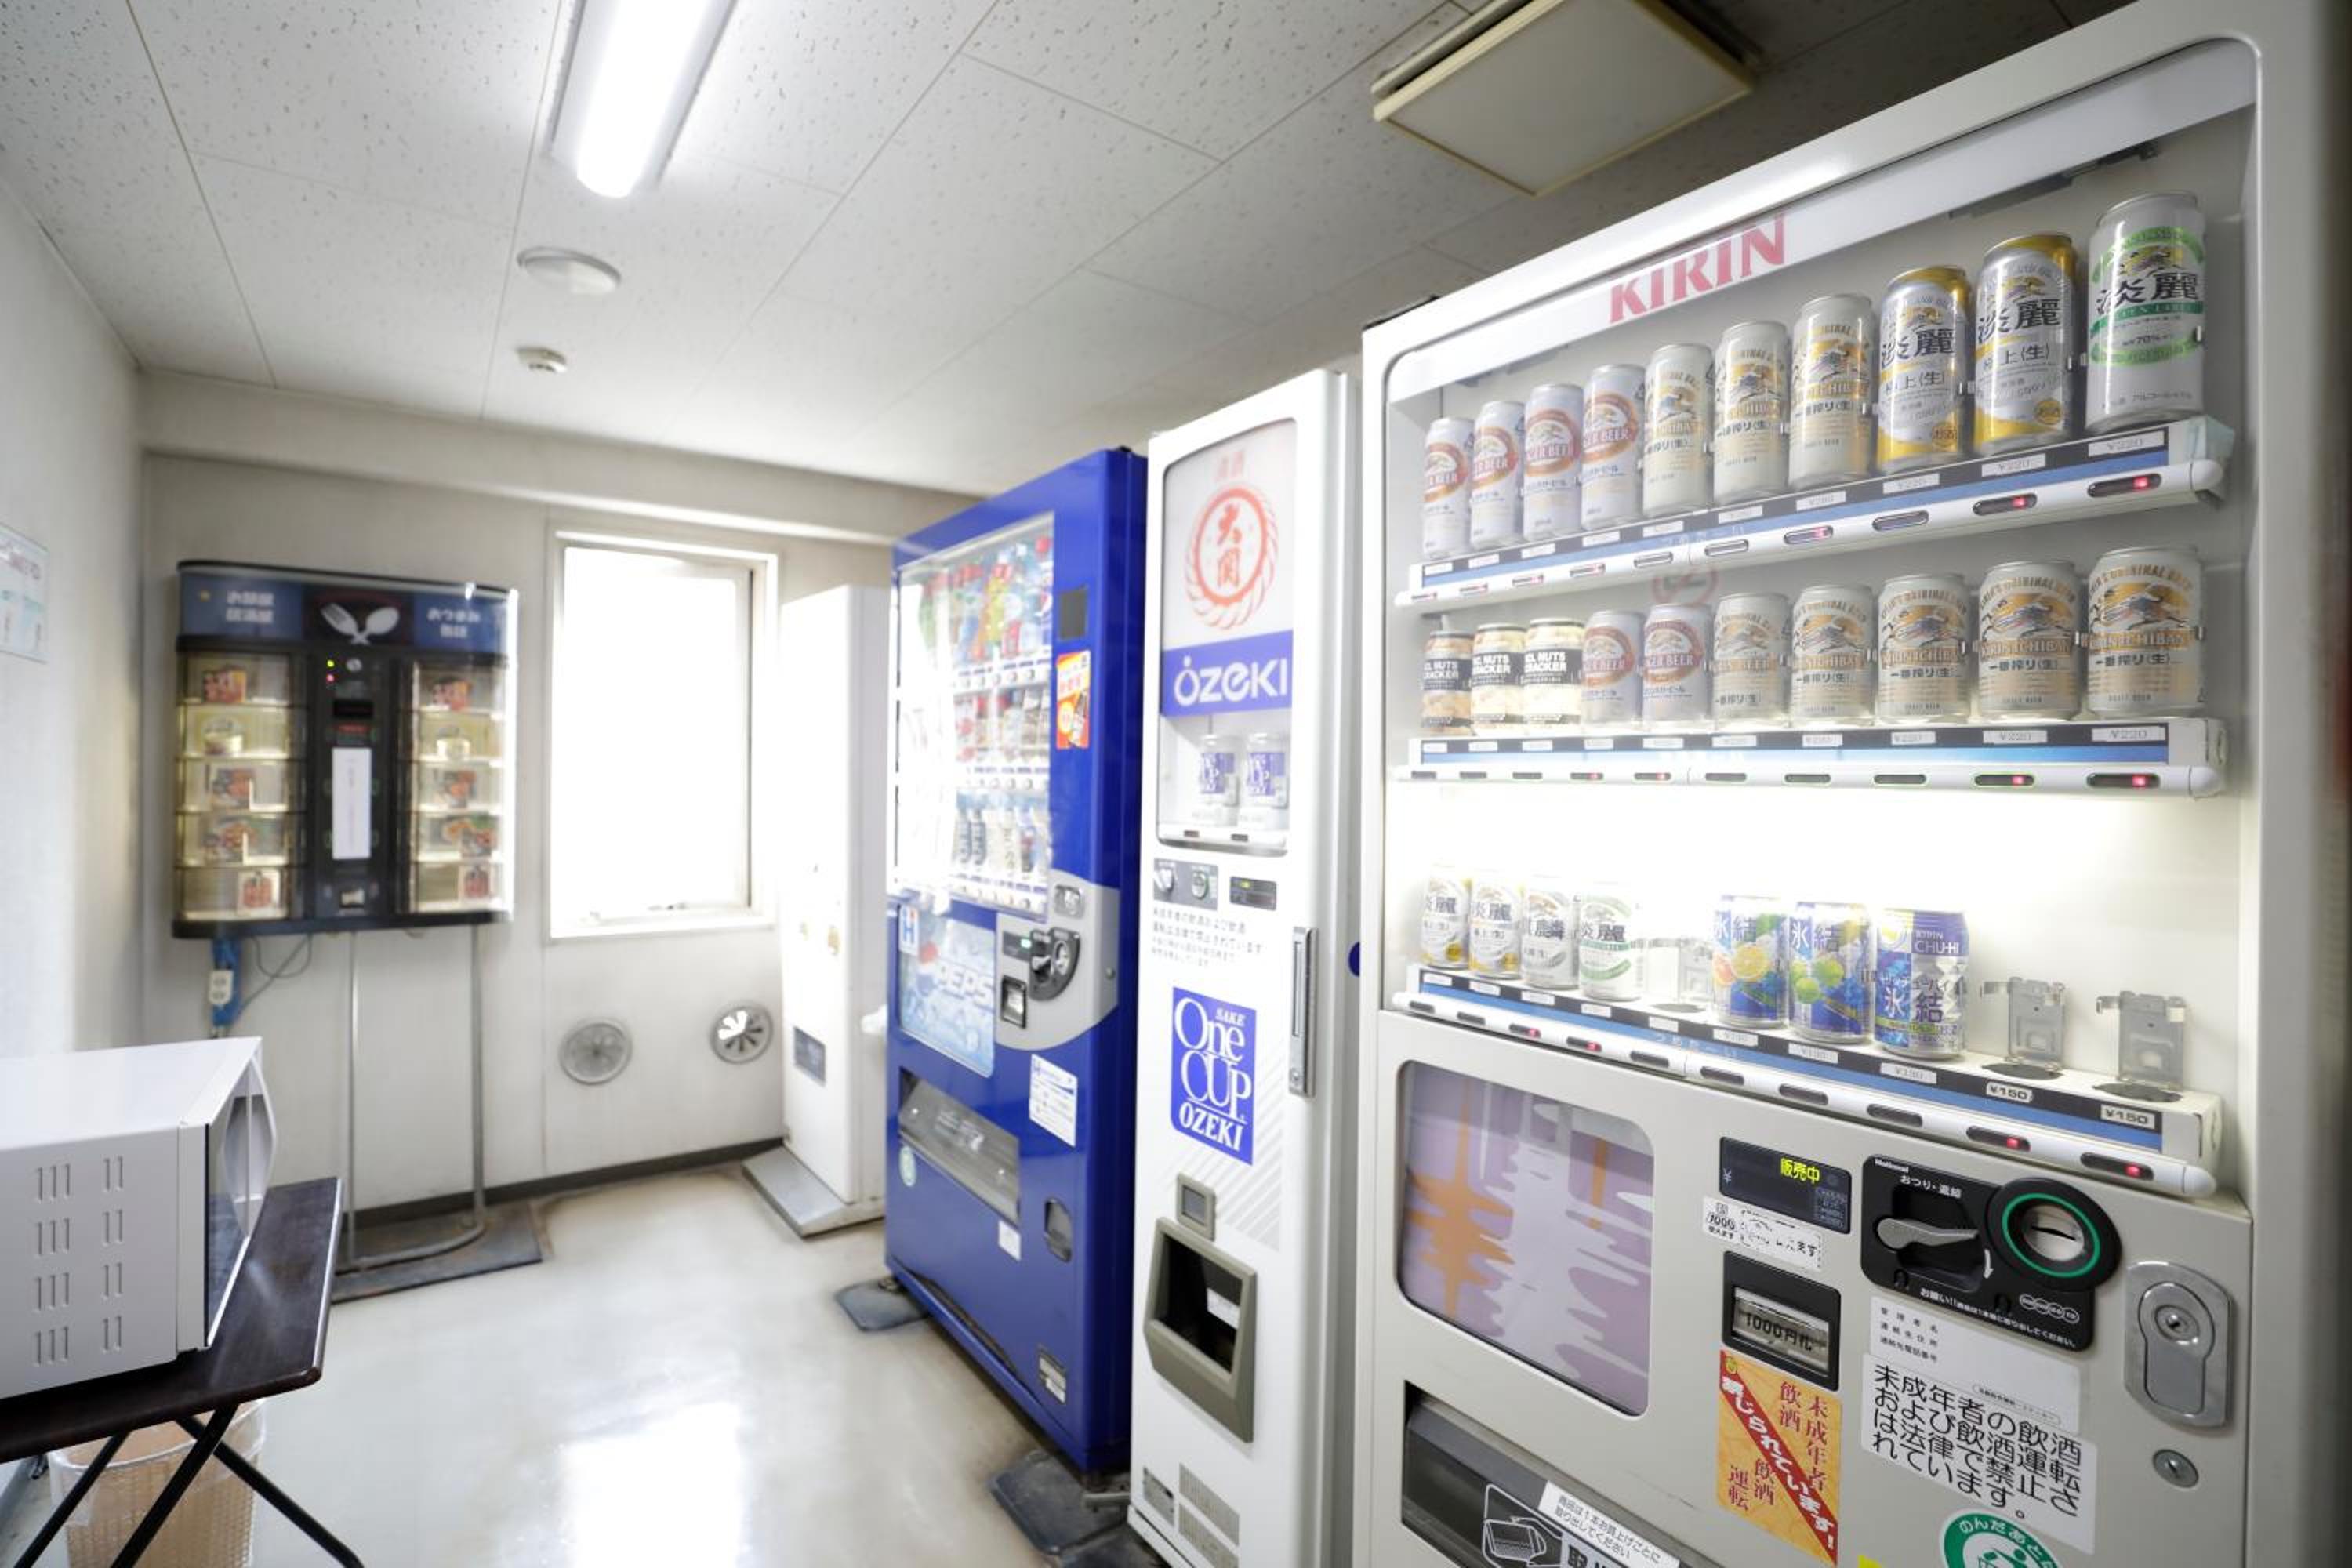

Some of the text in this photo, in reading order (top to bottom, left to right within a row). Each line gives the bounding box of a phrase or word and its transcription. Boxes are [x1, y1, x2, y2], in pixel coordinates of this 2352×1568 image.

[1610, 212, 1786, 323] KIRIN
[2096, 271, 2199, 315] 淡麗
[1978, 298, 2061, 343] 淡麗
[1881, 328, 1955, 368] 淡麗
[1524, 661, 1567, 673] RACKER
[1915, 941, 1959, 955] CHU-HI
[1175, 997, 1246, 1062] One
[1884, 985, 1944, 1024] 氷結
[1181, 1050, 1253, 1121] CUP
[1990, 1083, 2027, 1100] ¥150
[1178, 1102, 1245, 1152] OZEKI
[2105, 1109, 2149, 1124] ¥150
[1780, 1156, 1820, 1185] 販売中
[1780, 1381, 1801, 1434] 飲酒
[1875, 1364, 2082, 1467] 未成年者の飲酒
[1805, 1396, 1828, 1493] 未成年者
[1873, 1408, 2080, 1517] は法律で禁止さ
[1874, 1386, 2082, 1494] および飲酒運転
[1727, 1465, 1749, 1512] 運転
[1754, 1457, 1775, 1507] 飲酒
[1872, 1431, 2027, 1519] れています。
